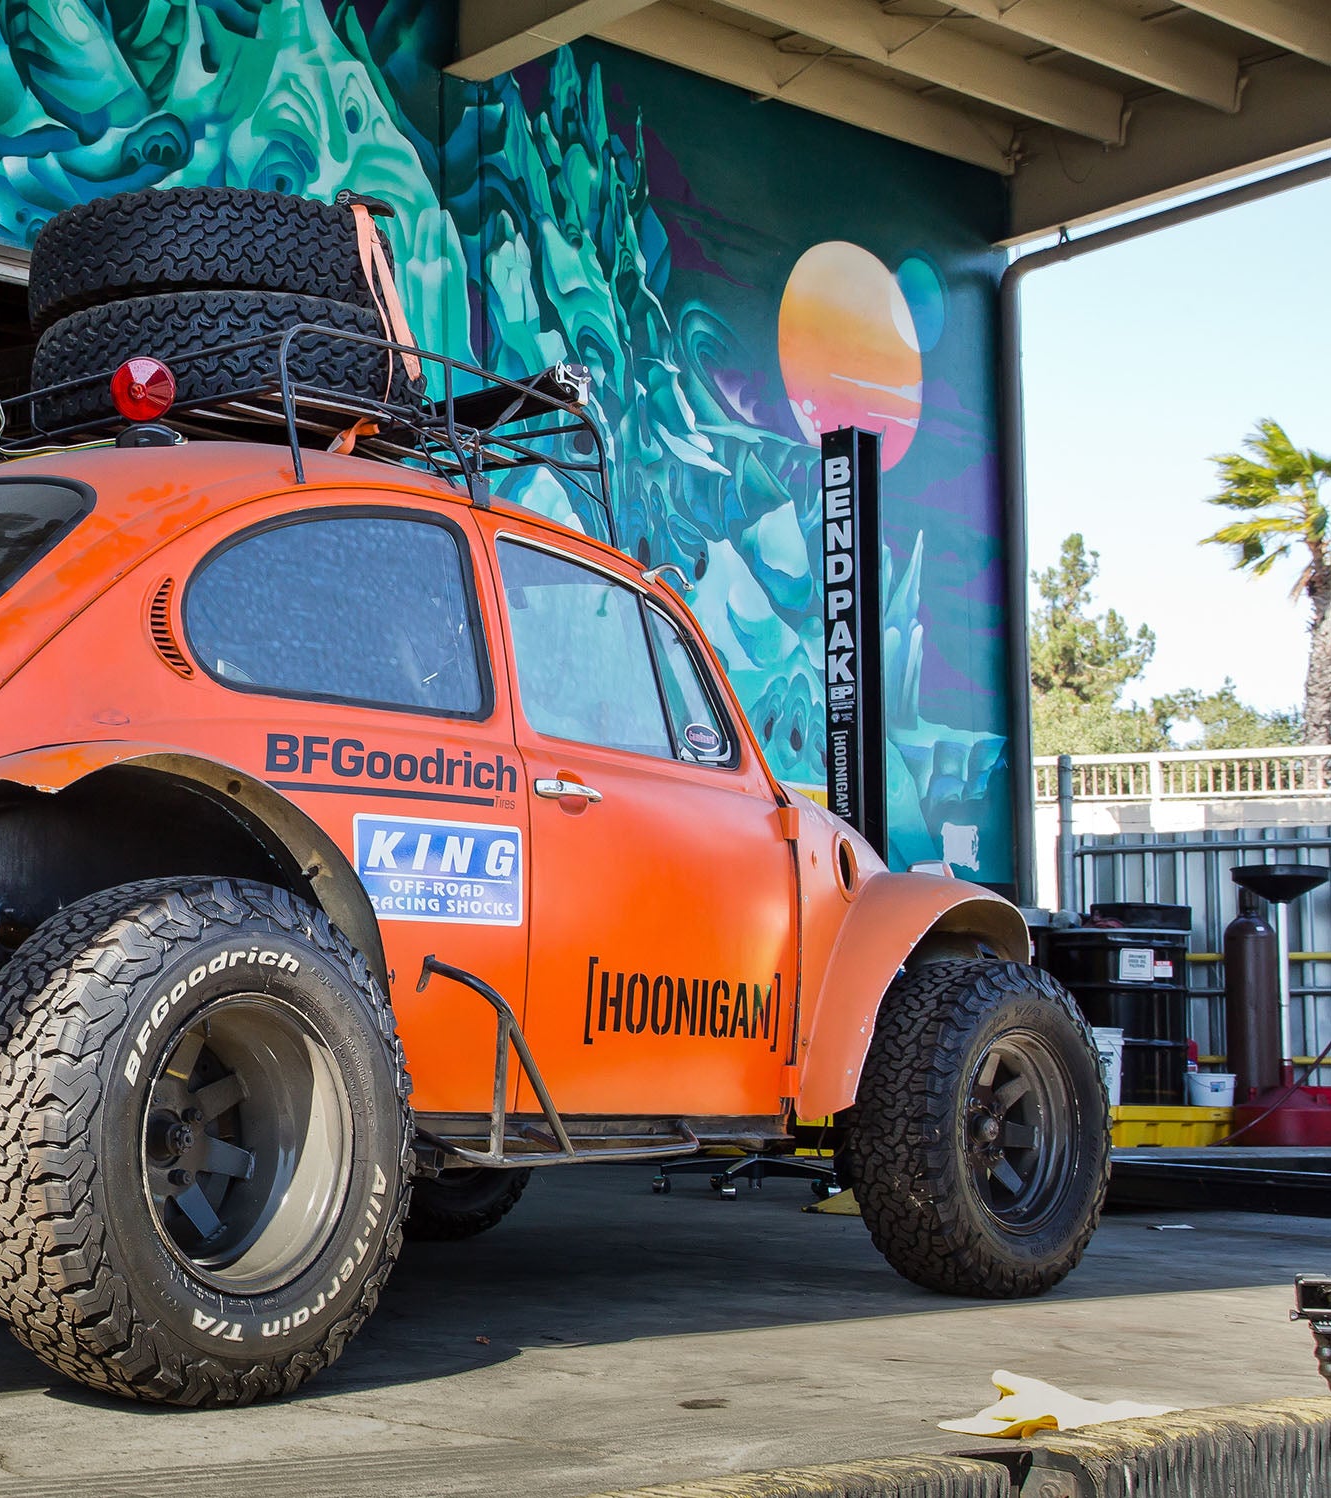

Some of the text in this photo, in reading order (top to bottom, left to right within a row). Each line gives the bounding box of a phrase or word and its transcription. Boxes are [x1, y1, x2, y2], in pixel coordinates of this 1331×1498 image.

[825, 455, 855, 684] BENDPAK
[265, 733, 517, 793] BFGoodrich
[495, 795, 516, 810] Tires
[366, 829, 516, 877] KING
[370, 895, 514, 916] RACING SHOCKS
[389, 879, 485, 898] OFF-ROAD
[124, 947, 300, 1087] BFGoodrich
[584, 956, 781, 1052] [HOONIGAN]
[261, 1164, 387, 1338] All-Terrain
[192, 1308, 244, 1343] T/A
